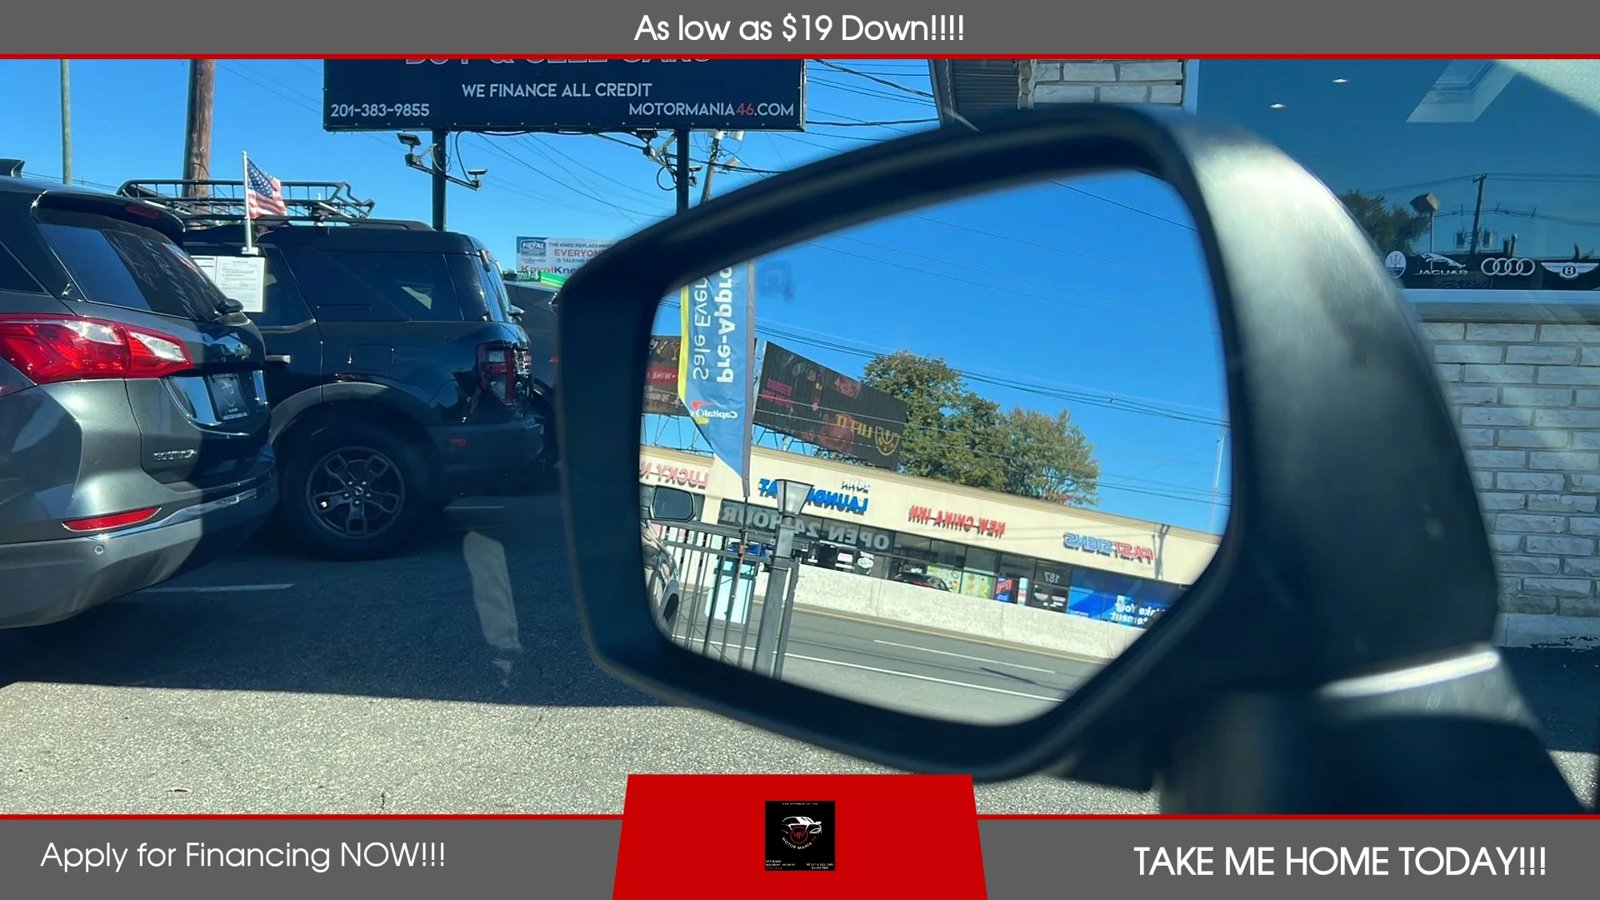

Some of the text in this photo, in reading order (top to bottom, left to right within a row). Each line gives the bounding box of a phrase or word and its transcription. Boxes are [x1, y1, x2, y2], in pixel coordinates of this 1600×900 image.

[461, 82, 653, 98] WE FINANCE ALL CREDIT
[329, 103, 431, 118] 201-383-9855
[628, 101, 795, 118] MOTORMANIA46.COM
